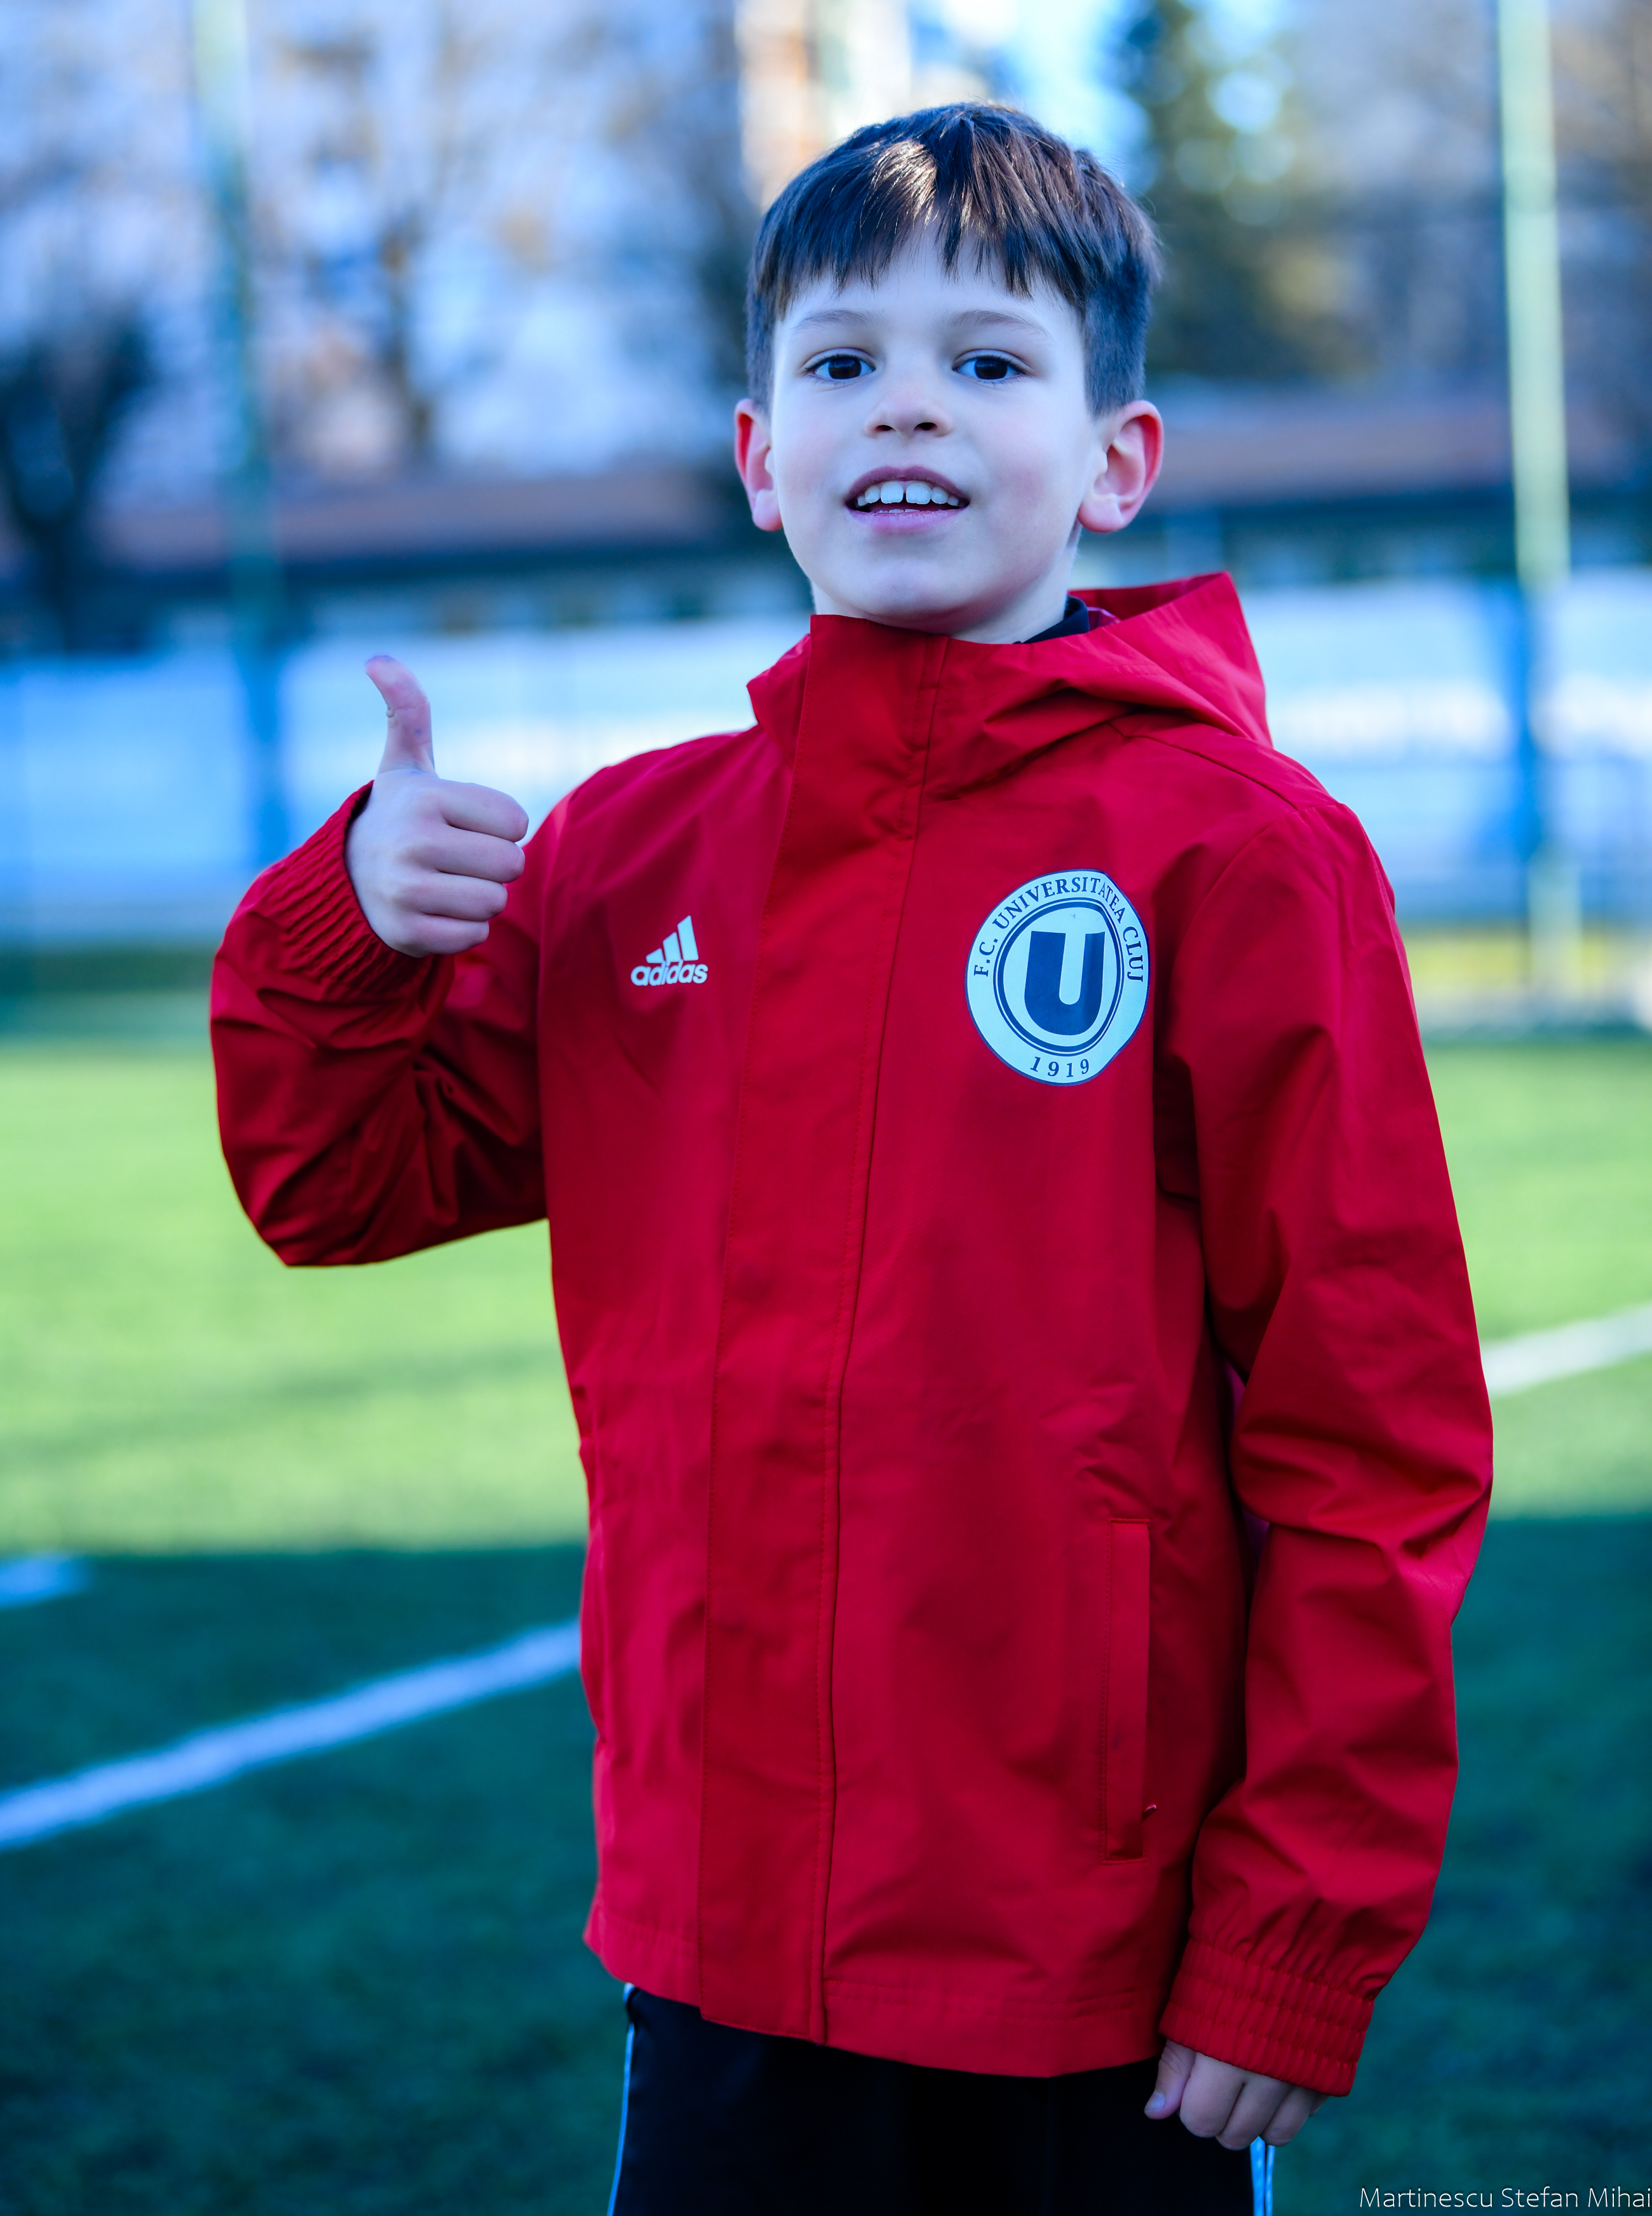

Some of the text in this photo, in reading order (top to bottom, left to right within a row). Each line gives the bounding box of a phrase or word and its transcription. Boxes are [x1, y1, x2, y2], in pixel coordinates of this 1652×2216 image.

[973, 876, 1144, 982] F.C. UNIVERSITATEA CLUJ
[630, 960, 708, 986] adidas
[1024, 930, 1106, 1036] U
[1030, 1056, 1089, 1078] 1919
